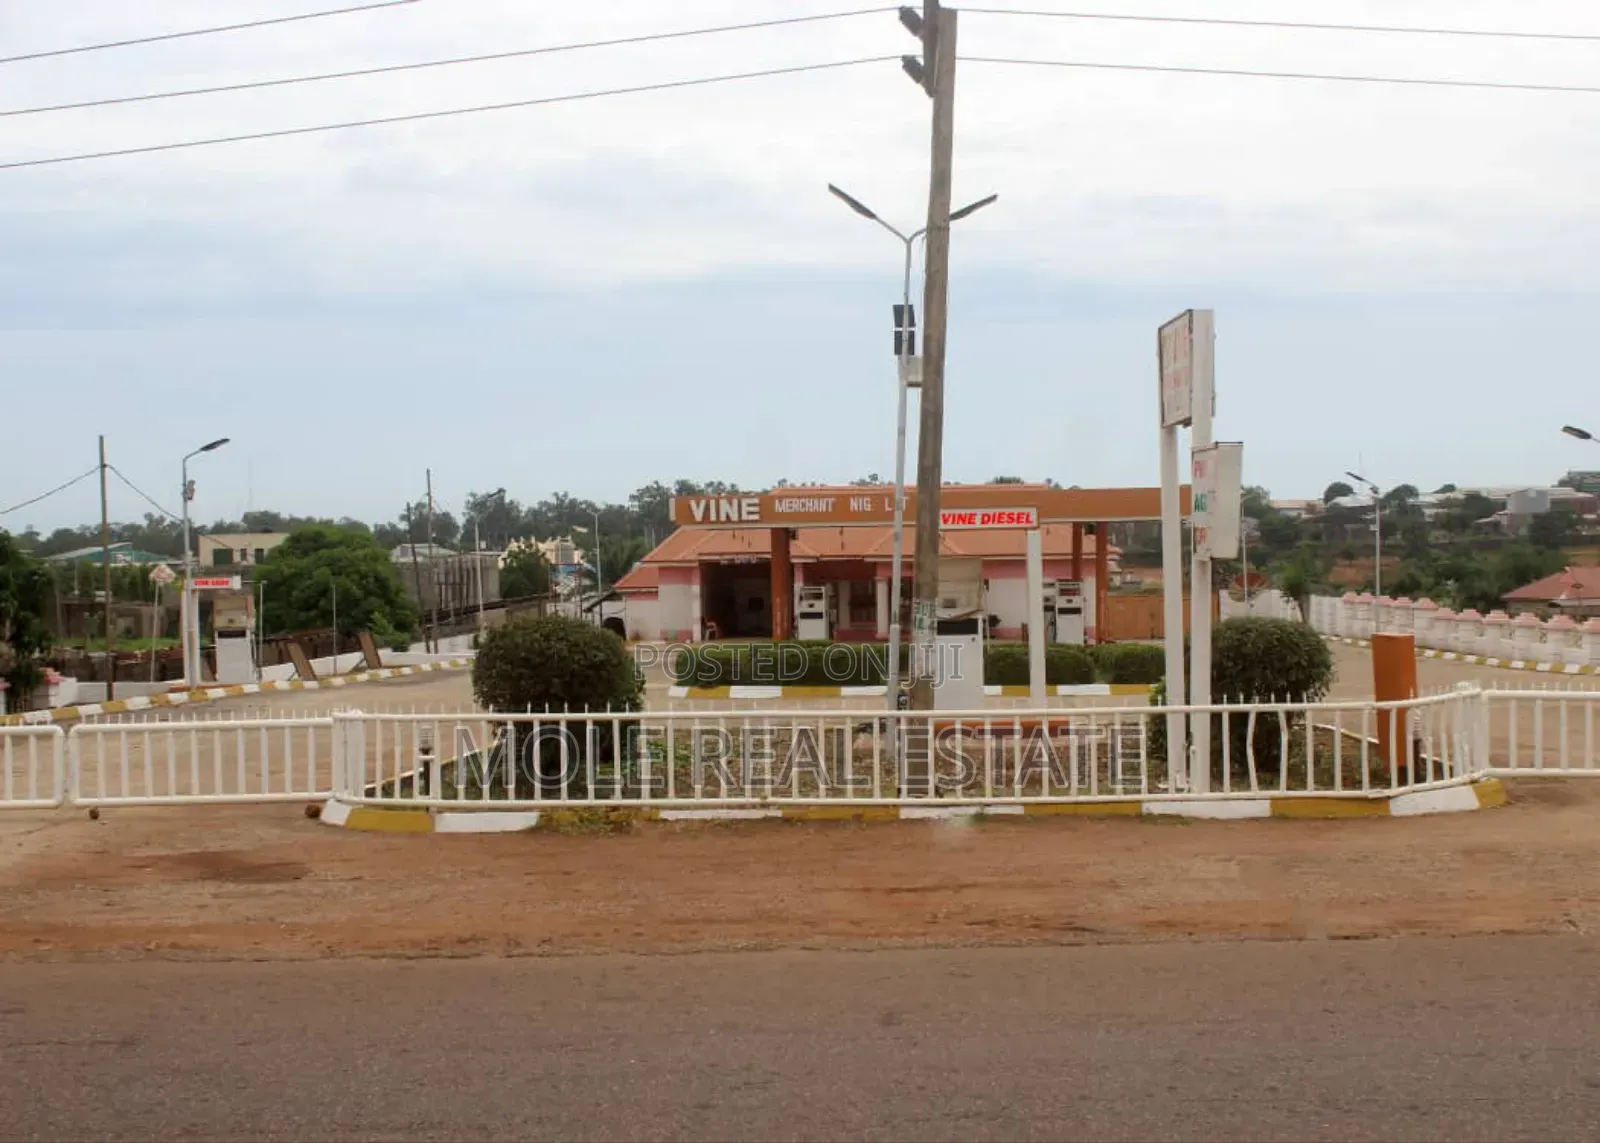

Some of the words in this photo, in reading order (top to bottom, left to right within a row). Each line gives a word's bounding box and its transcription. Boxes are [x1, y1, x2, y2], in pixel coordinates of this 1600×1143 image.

[689, 498, 761, 522] VINE
[774, 498, 835, 513] MERCHANT
[849, 497, 872, 512] NIG
[941, 511, 978, 525] VINE
[980, 511, 1033, 525] DIESEL
